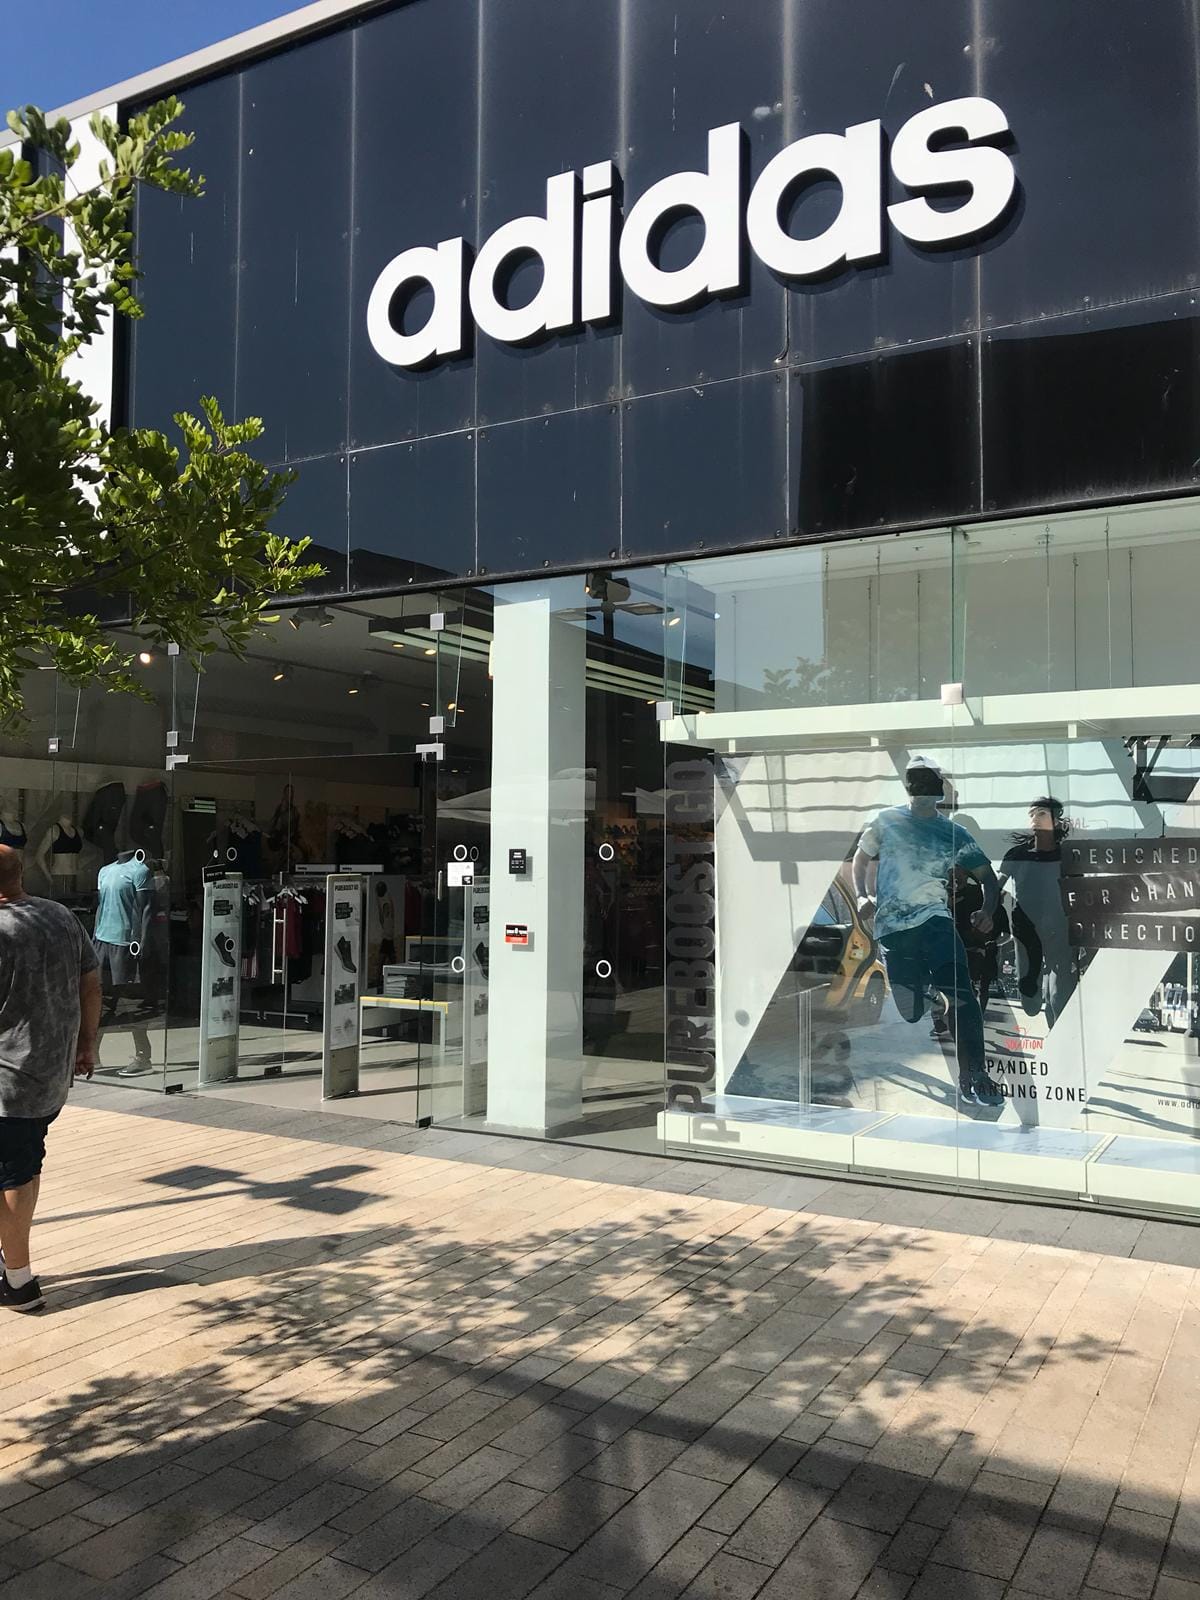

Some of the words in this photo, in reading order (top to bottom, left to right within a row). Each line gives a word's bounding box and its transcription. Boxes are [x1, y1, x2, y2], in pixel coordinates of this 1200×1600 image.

[367, 97, 1014, 366] adidas
[1130, 881, 1194, 902] CHAN
[1046, 1086, 1086, 1102] ZONE
